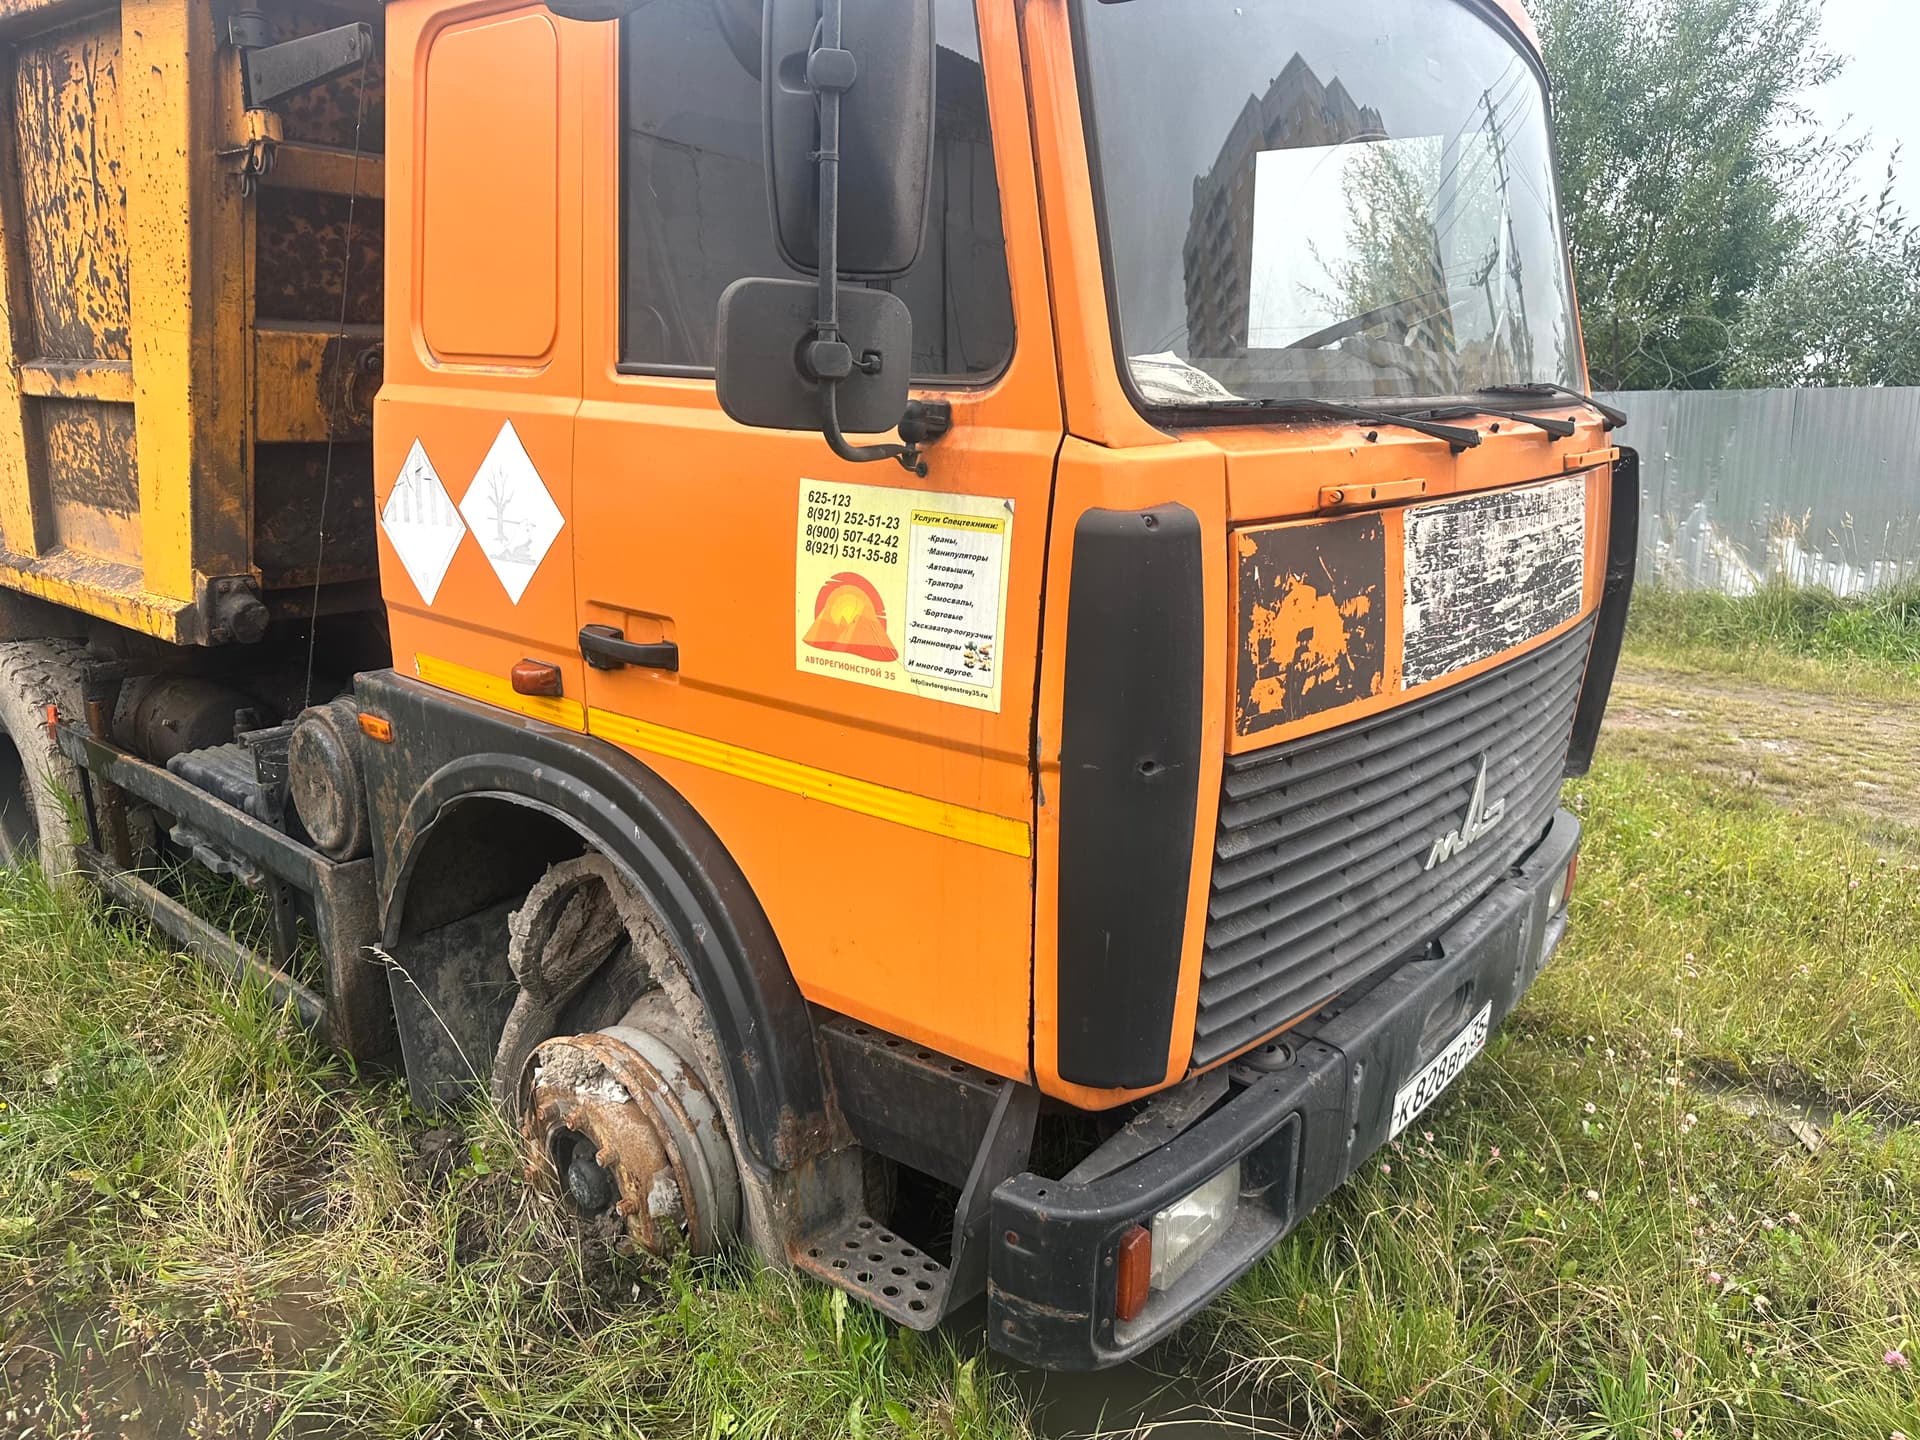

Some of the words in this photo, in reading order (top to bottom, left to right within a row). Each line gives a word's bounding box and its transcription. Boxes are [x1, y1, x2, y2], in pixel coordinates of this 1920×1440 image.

[808, 490, 851, 508] 625-123
[807, 506, 841, 526] 8(921)
[843, 511, 900, 530] 252-51-23
[913, 513, 941, 524] Услуги
[942, 516, 999, 530] Спецтехники:
[806, 524, 840, 543] 8(900)
[842, 529, 899, 548] 507-42-42
[927, 534, 958, 546] -Краны,
[805, 540, 839, 559] 8(921)
[841, 545, 898, 565] 531-35-88
[927, 547, 989, 562] -Манипуляторы
[926, 562, 975, 578] -Автовышки,
[925, 578, 964, 591] -Трактора
[805, 655, 882, 678] АВТОРЕГИОНСТРОЙ
[884, 671, 896, 681] 35
[908, 659, 915, 667] И
[915, 662, 943, 672] многое
[944, 666, 974, 678] другое.
